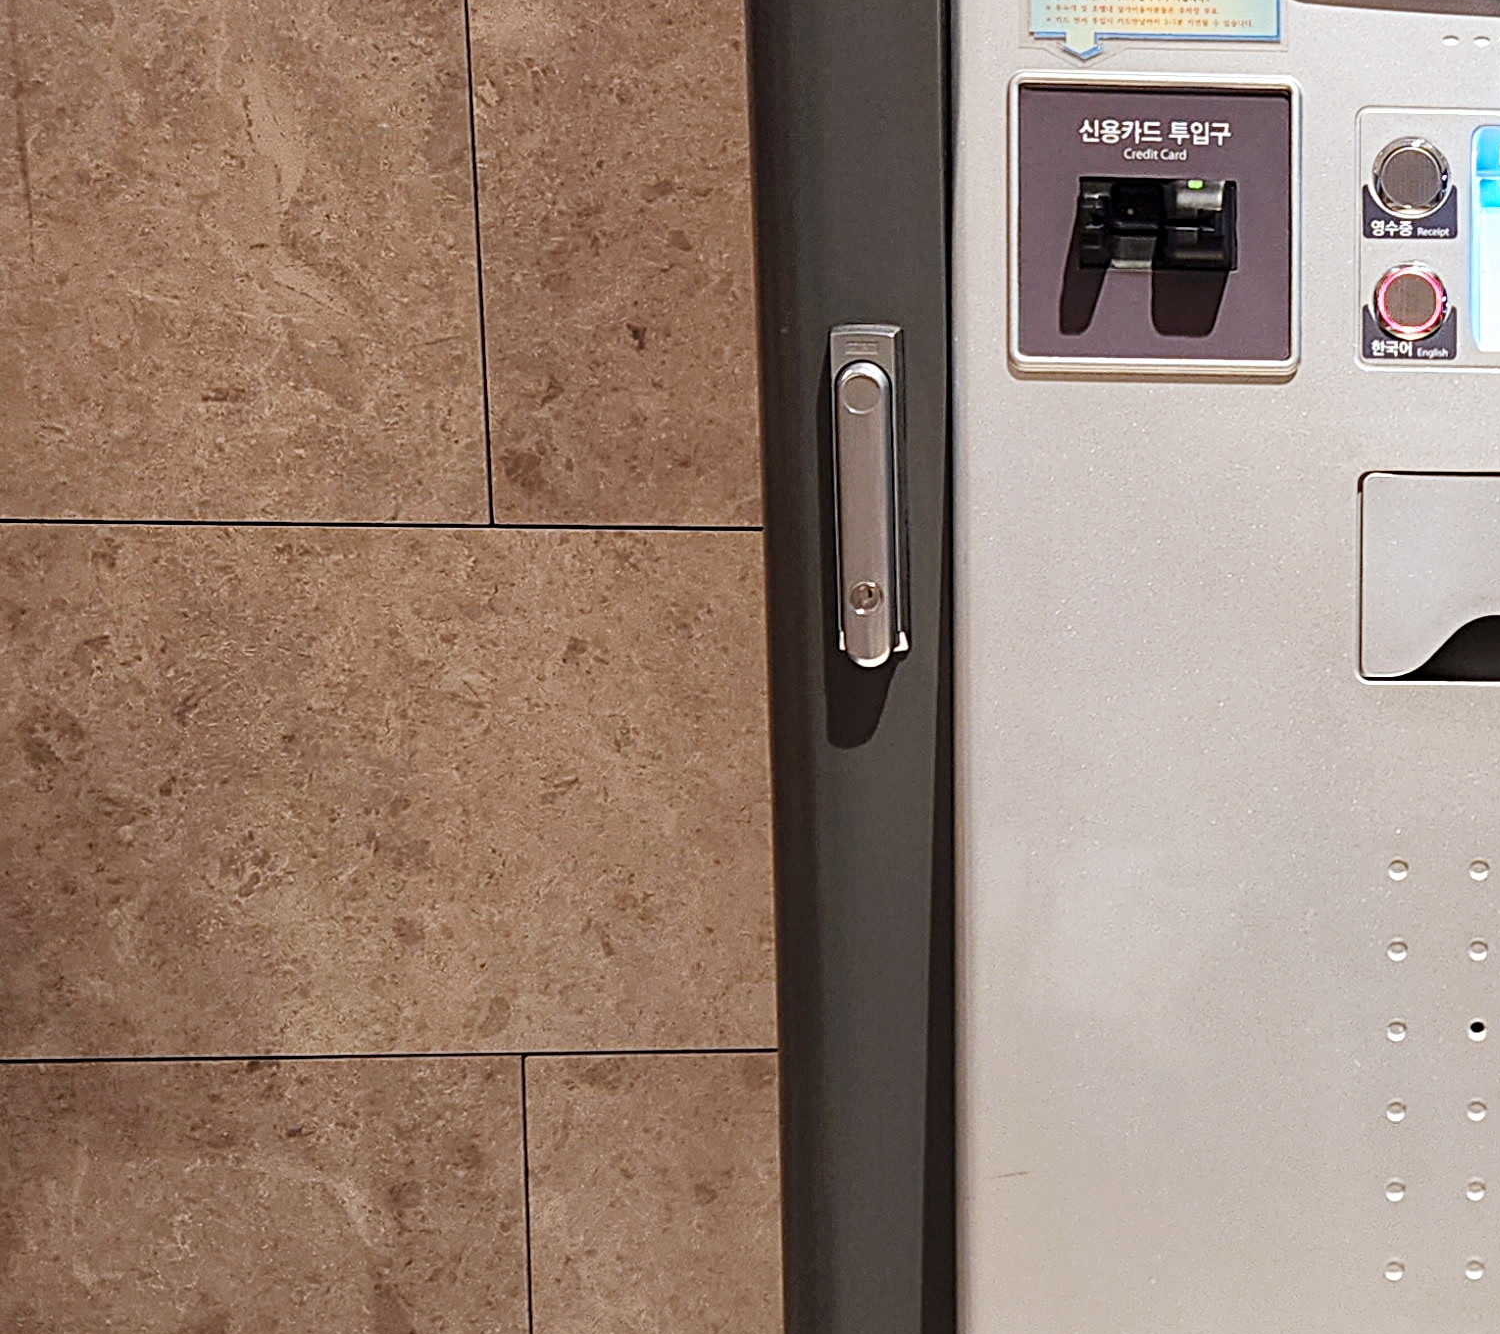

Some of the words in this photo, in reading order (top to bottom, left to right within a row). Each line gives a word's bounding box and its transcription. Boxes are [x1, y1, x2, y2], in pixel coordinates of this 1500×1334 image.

[1079, 119, 1162, 143] 신용카드
[1169, 122, 1232, 146] 투입구
[1123, 148, 1158, 160] Credit
[1160, 149, 1187, 161] Card
[1371, 220, 1413, 236] 영수증
[1417, 227, 1450, 237] Receipt
[1371, 339, 1413, 357] 한국어
[1417, 348, 1448, 359] English
